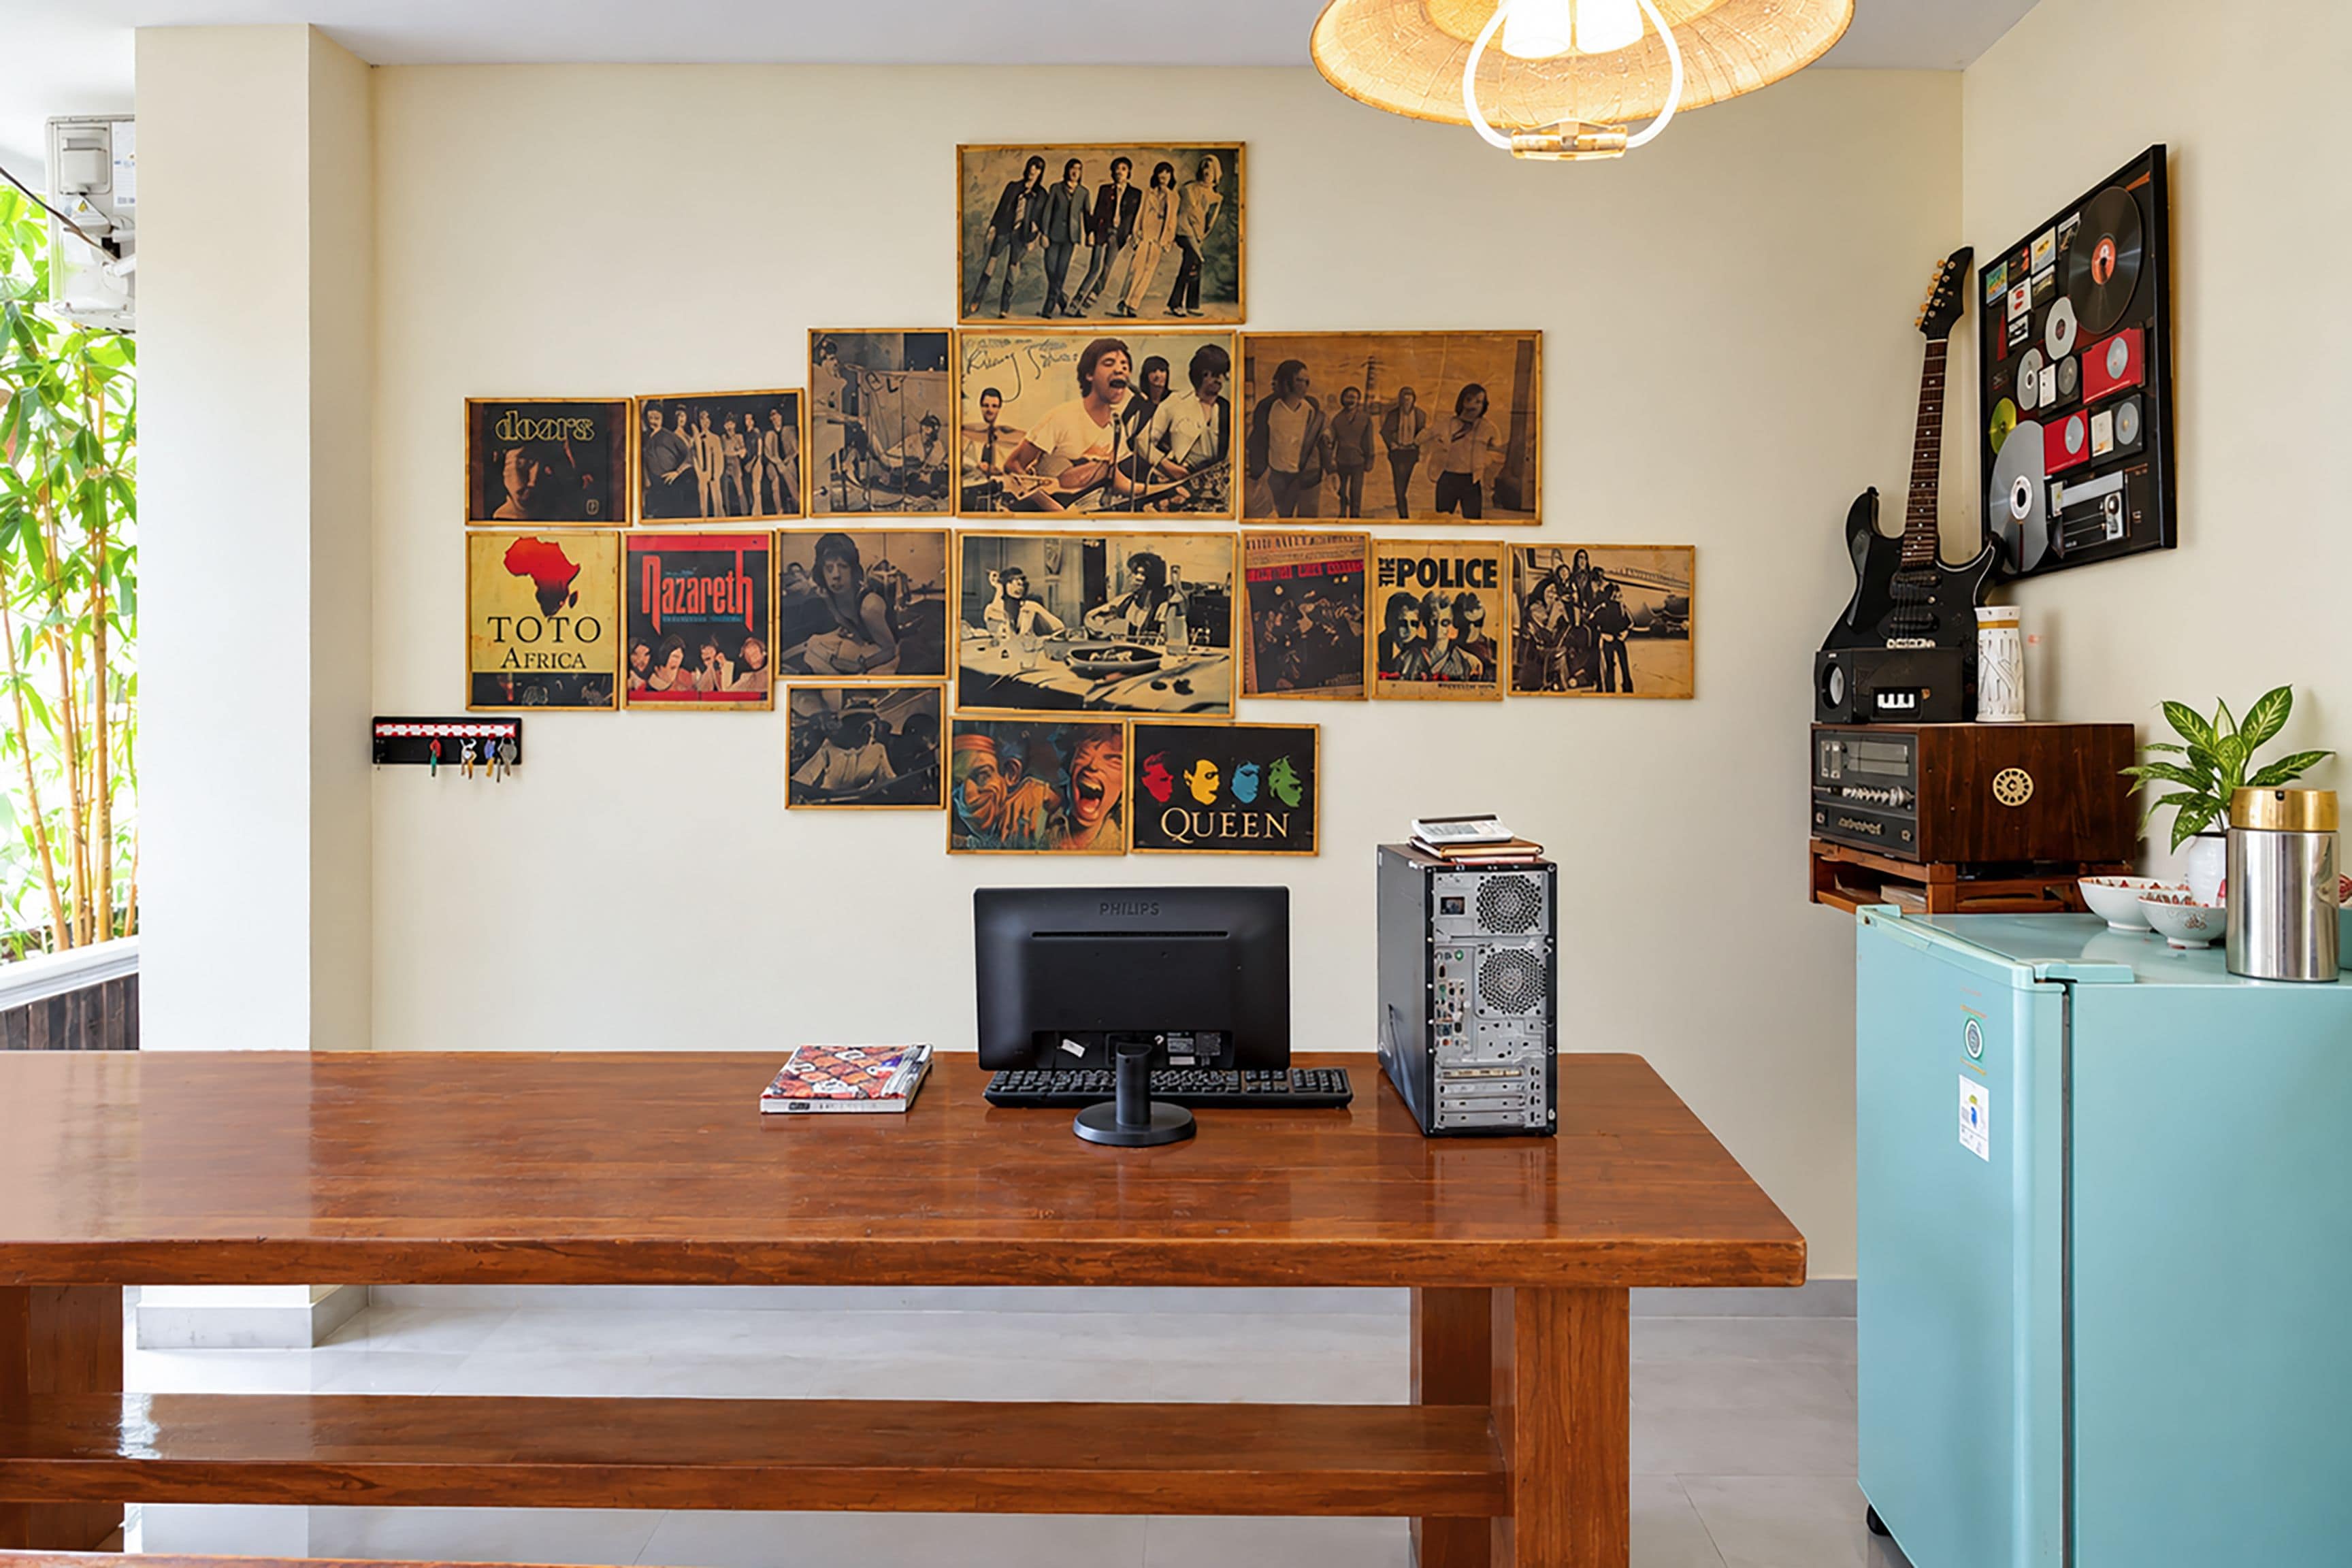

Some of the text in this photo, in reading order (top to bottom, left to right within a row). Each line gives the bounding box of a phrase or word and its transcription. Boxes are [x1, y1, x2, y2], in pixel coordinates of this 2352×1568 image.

[495, 410, 595, 441] doors
[1378, 557, 1395, 588] THE
[1396, 557, 1497, 589] POLICE
[487, 615, 602, 643] TOTO
[500, 647, 587, 669] AFRICA
[1160, 807, 1290, 845] QUEEN
[1099, 902, 1160, 915] PHILIPS
